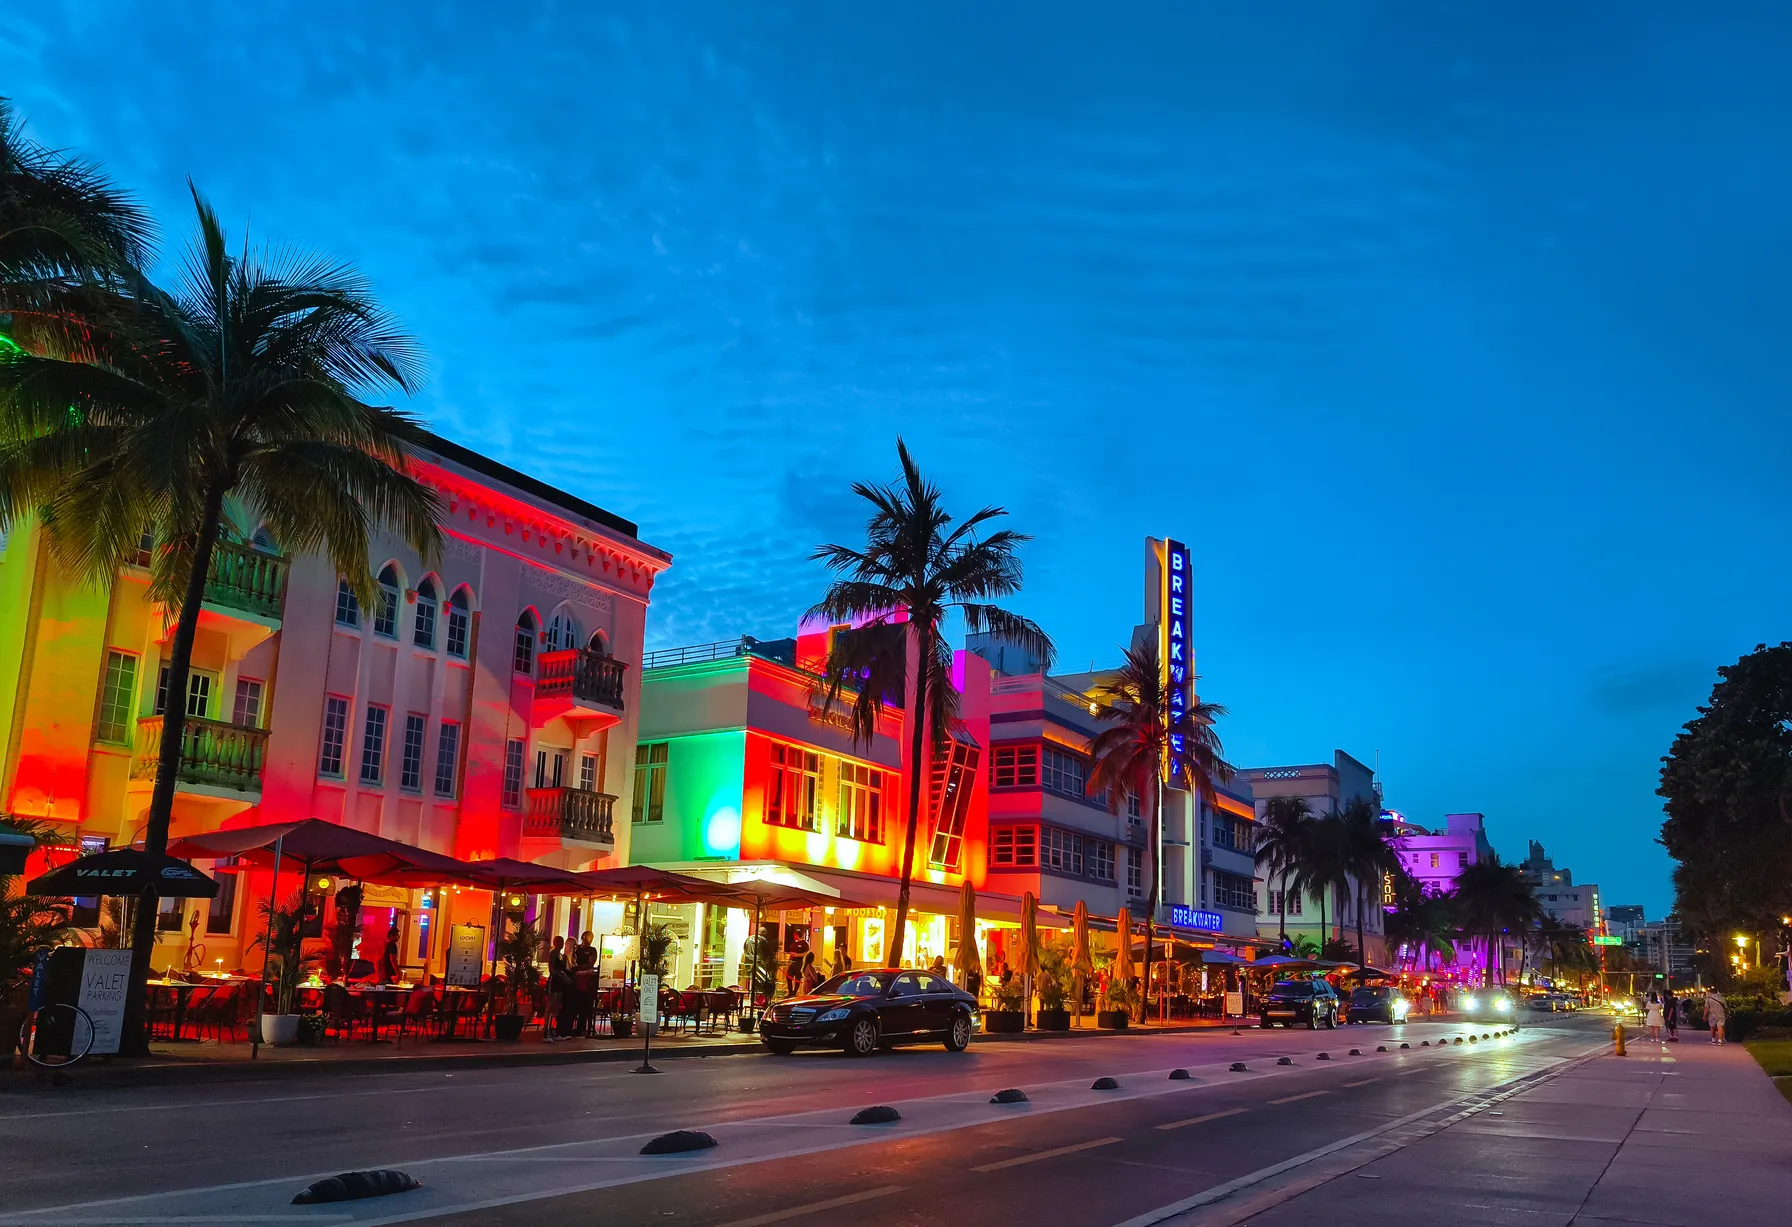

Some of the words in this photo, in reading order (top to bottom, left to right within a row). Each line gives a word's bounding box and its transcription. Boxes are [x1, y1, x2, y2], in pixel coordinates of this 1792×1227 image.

[76, 869, 137, 877] VALET
[1173, 908, 1221, 930] BREAKWATER
[87, 954, 130, 966] WELCOME
[33, 953, 46, 996] VALET
[86, 973, 125, 990] VALET
[643, 977, 656, 986] VALET
[86, 990, 122, 1001] PARKING
